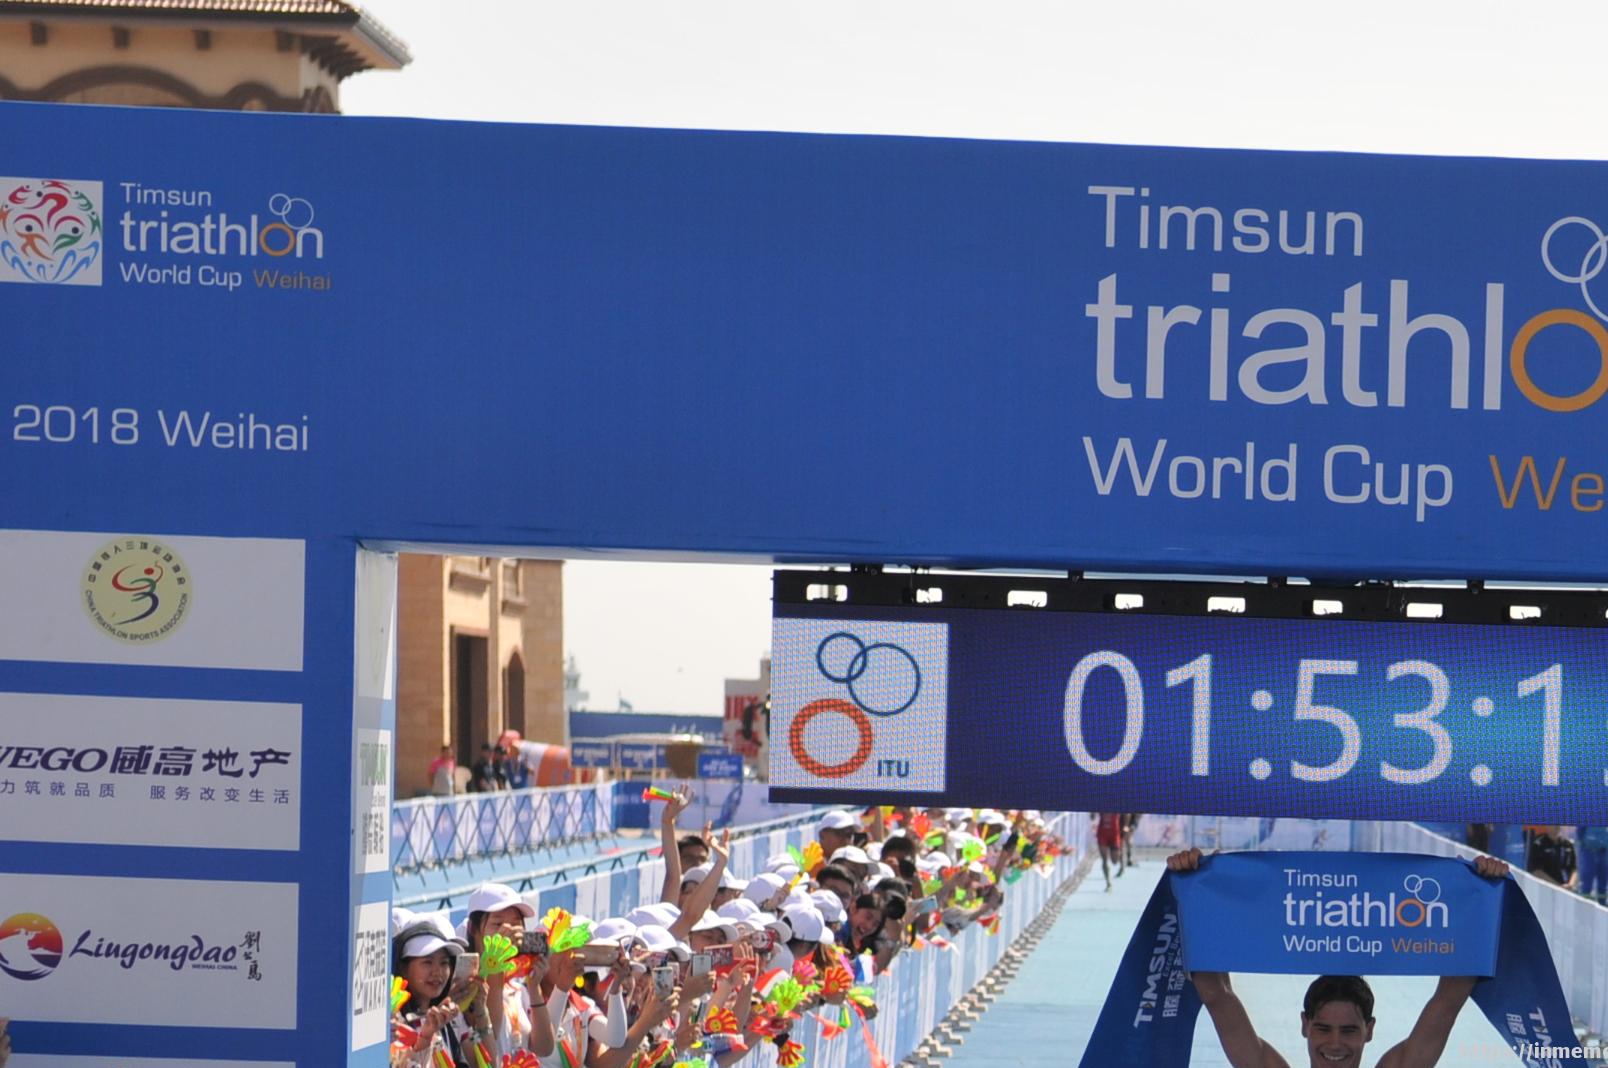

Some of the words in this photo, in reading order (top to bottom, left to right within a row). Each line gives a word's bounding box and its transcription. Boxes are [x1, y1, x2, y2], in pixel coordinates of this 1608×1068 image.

[120, 183, 212, 206] Timsun
[120, 211, 323, 259] triathlon
[1088, 185, 1363, 256] Timsun
[120, 262, 190, 285] World
[199, 265, 242, 291] Cup
[252, 269, 331, 290] Weihai
[13, 404, 139, 445] 2018
[158, 409, 308, 451] Weihai
[1083, 436, 1297, 502] World
[1323, 443, 1453, 522] Cup
[877, 758, 909, 778] ITU
[150, 785, 290, 805] 服务改变生活
[1284, 869, 1358, 888] Timsun
[1283, 892, 1449, 927] triathlon
[69, 929, 237, 970] Liugongdao
[1283, 936, 1341, 953] World
[1347, 937, 1383, 958] Cup
[1391, 937, 1455, 954] Weihai
